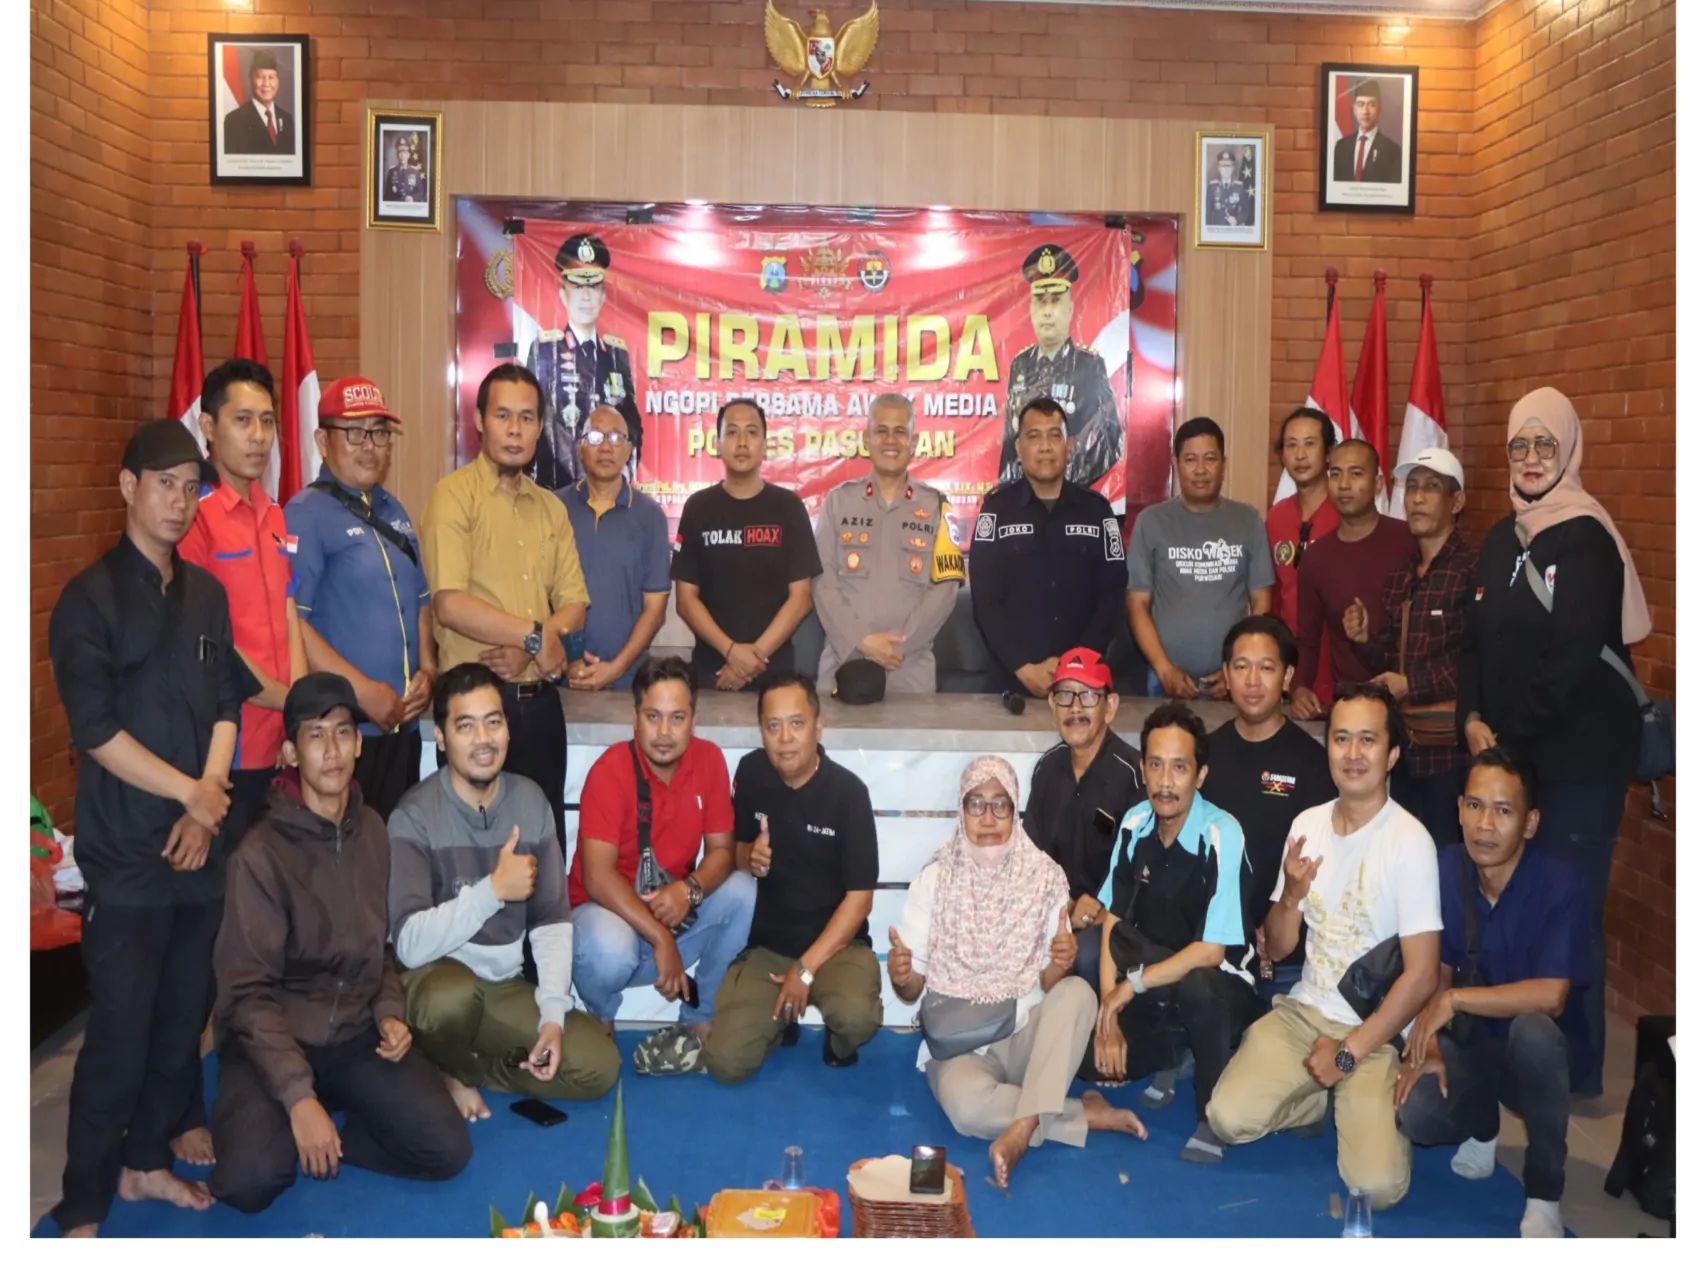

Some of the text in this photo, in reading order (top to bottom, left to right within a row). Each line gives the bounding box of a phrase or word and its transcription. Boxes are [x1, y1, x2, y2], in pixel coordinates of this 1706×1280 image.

[647, 311, 999, 382] PIRAMIDA
[645, 390, 718, 415] NGOPI
[726, 391, 838, 417] RSAMA
[924, 392, 998, 416] MEDIA
[688, 428, 955, 459] POES PASUAN
[841, 517, 874, 527] AZIZ
[902, 521, 935, 535] POLRI
[702, 527, 781, 546] TOLAK HOAX
[1004, 525, 1028, 536] JOKO
[1070, 526, 1096, 535] POLRI
[1168, 547, 1203, 560] DISKO
